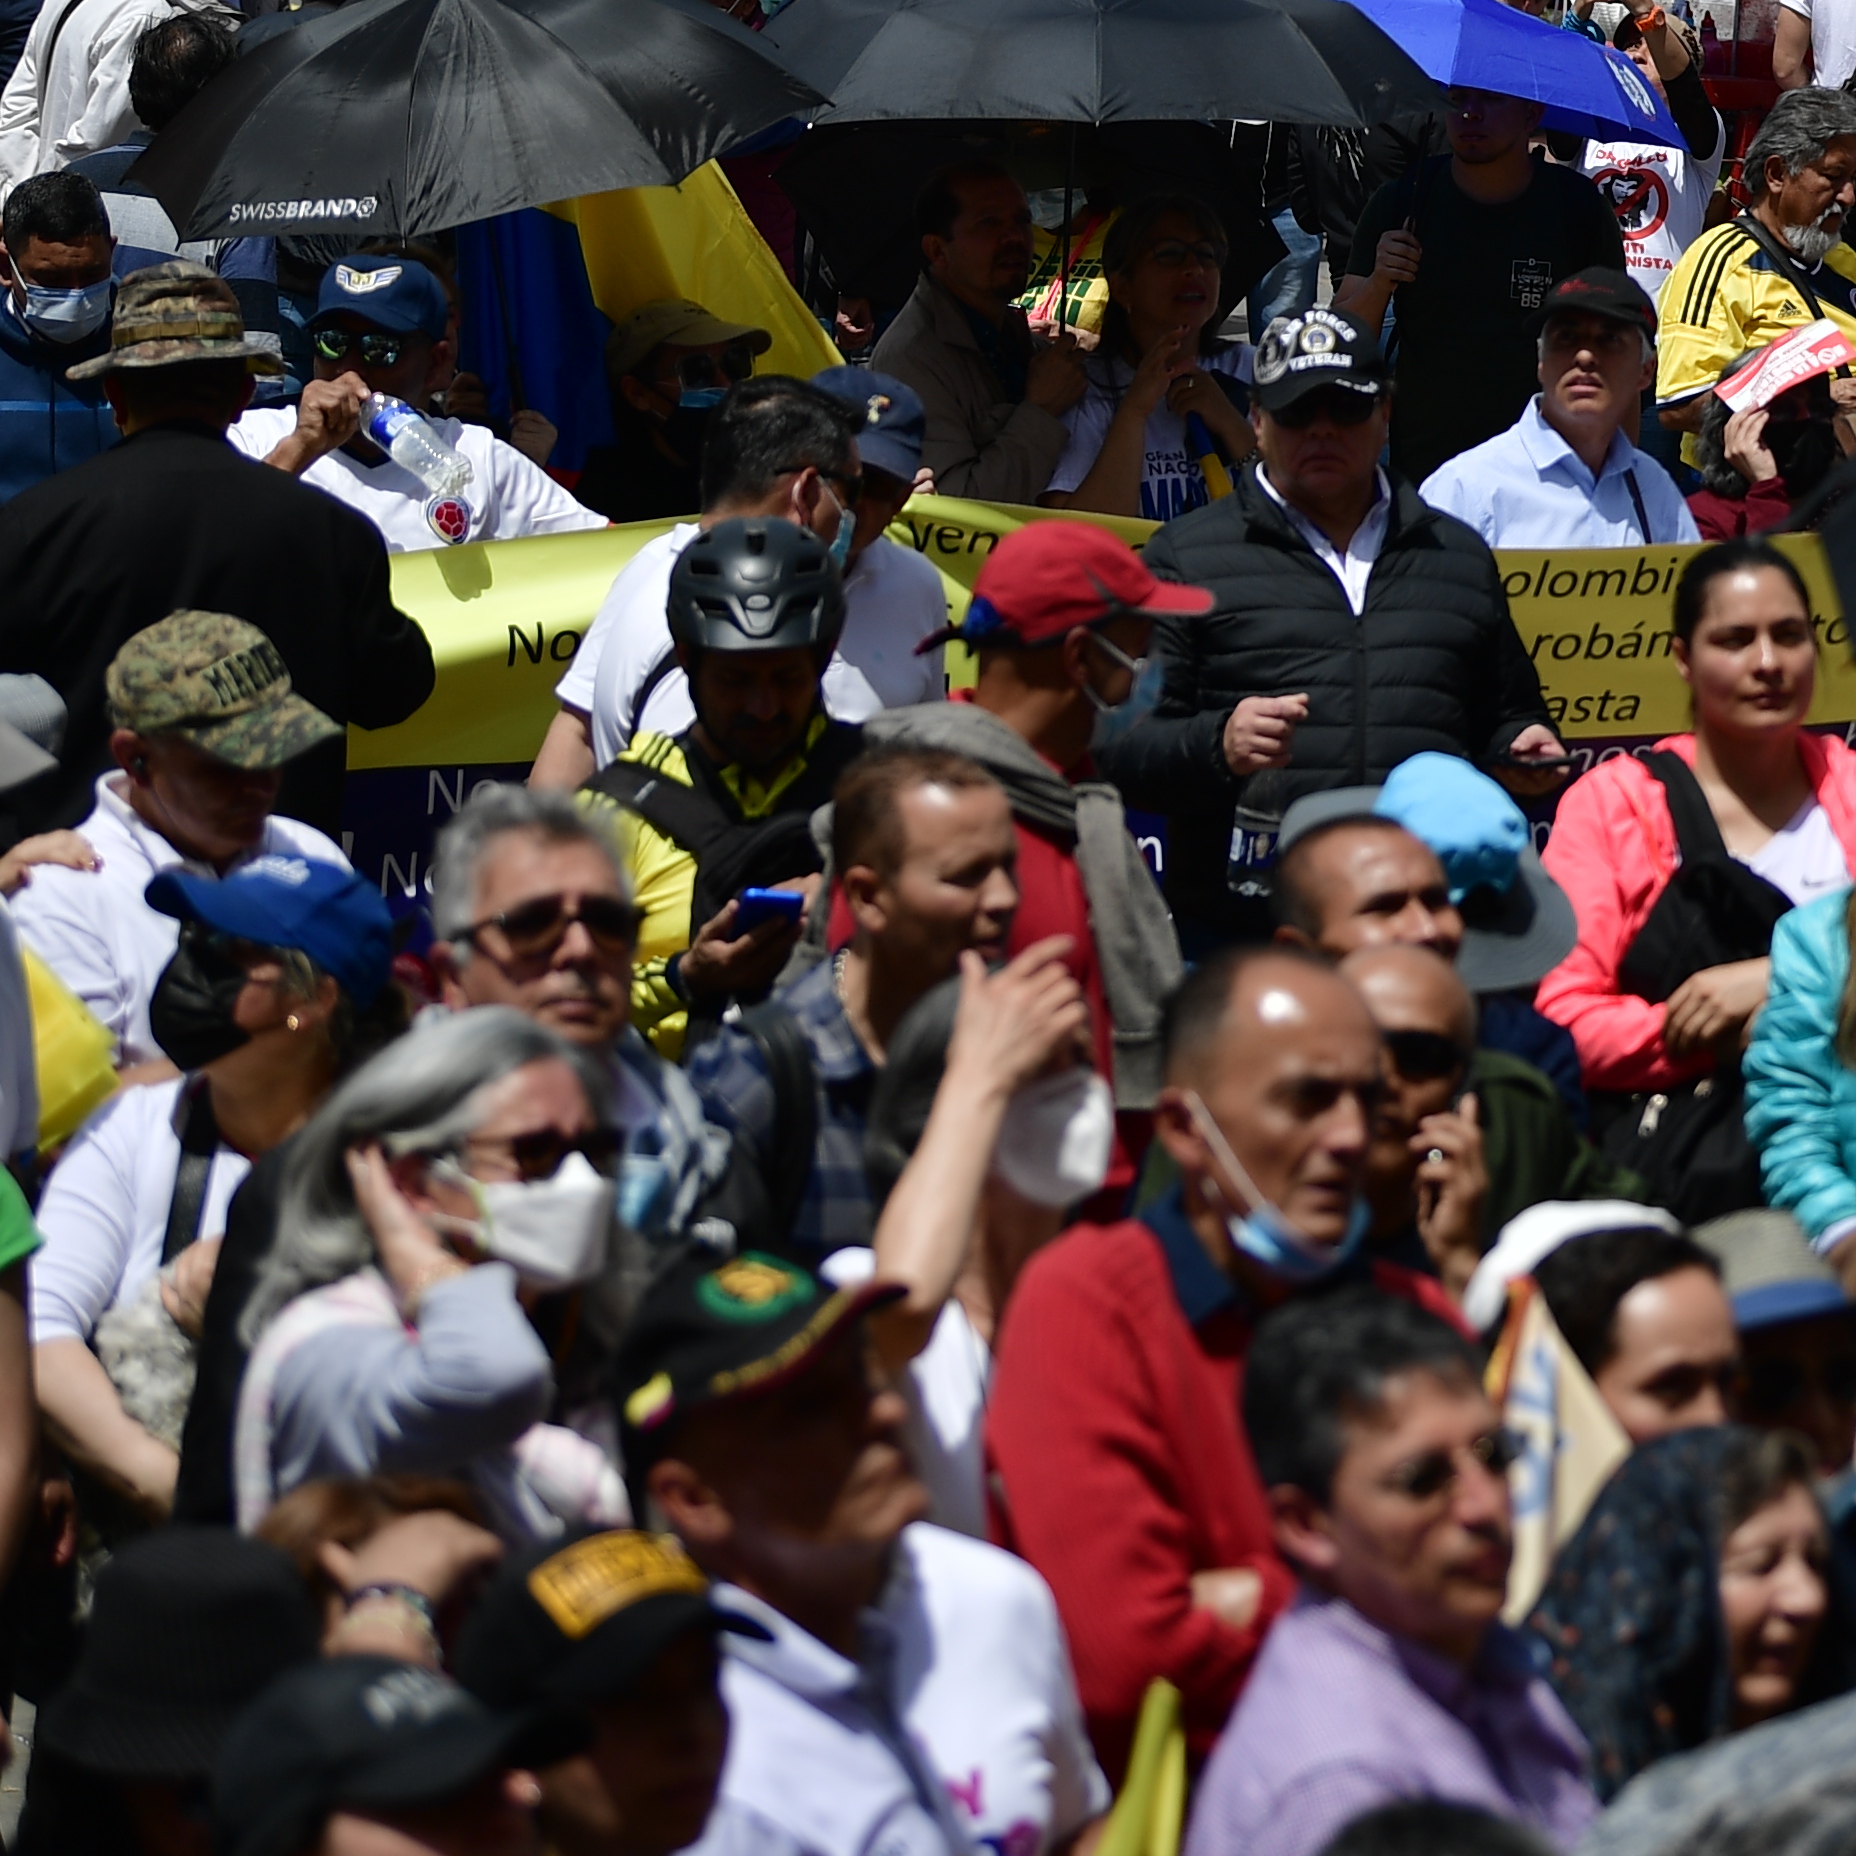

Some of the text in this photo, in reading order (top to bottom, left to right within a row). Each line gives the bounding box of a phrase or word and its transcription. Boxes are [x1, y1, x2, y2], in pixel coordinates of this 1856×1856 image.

[229, 199, 355, 221] SWISSBRAND
[1626, 256, 1674, 271] NISTA
[1520, 292, 1543, 309] 85
[1502, 558, 1680, 599] olombi
[508, 621, 581, 667] No
[1530, 621, 1680, 662] robán
